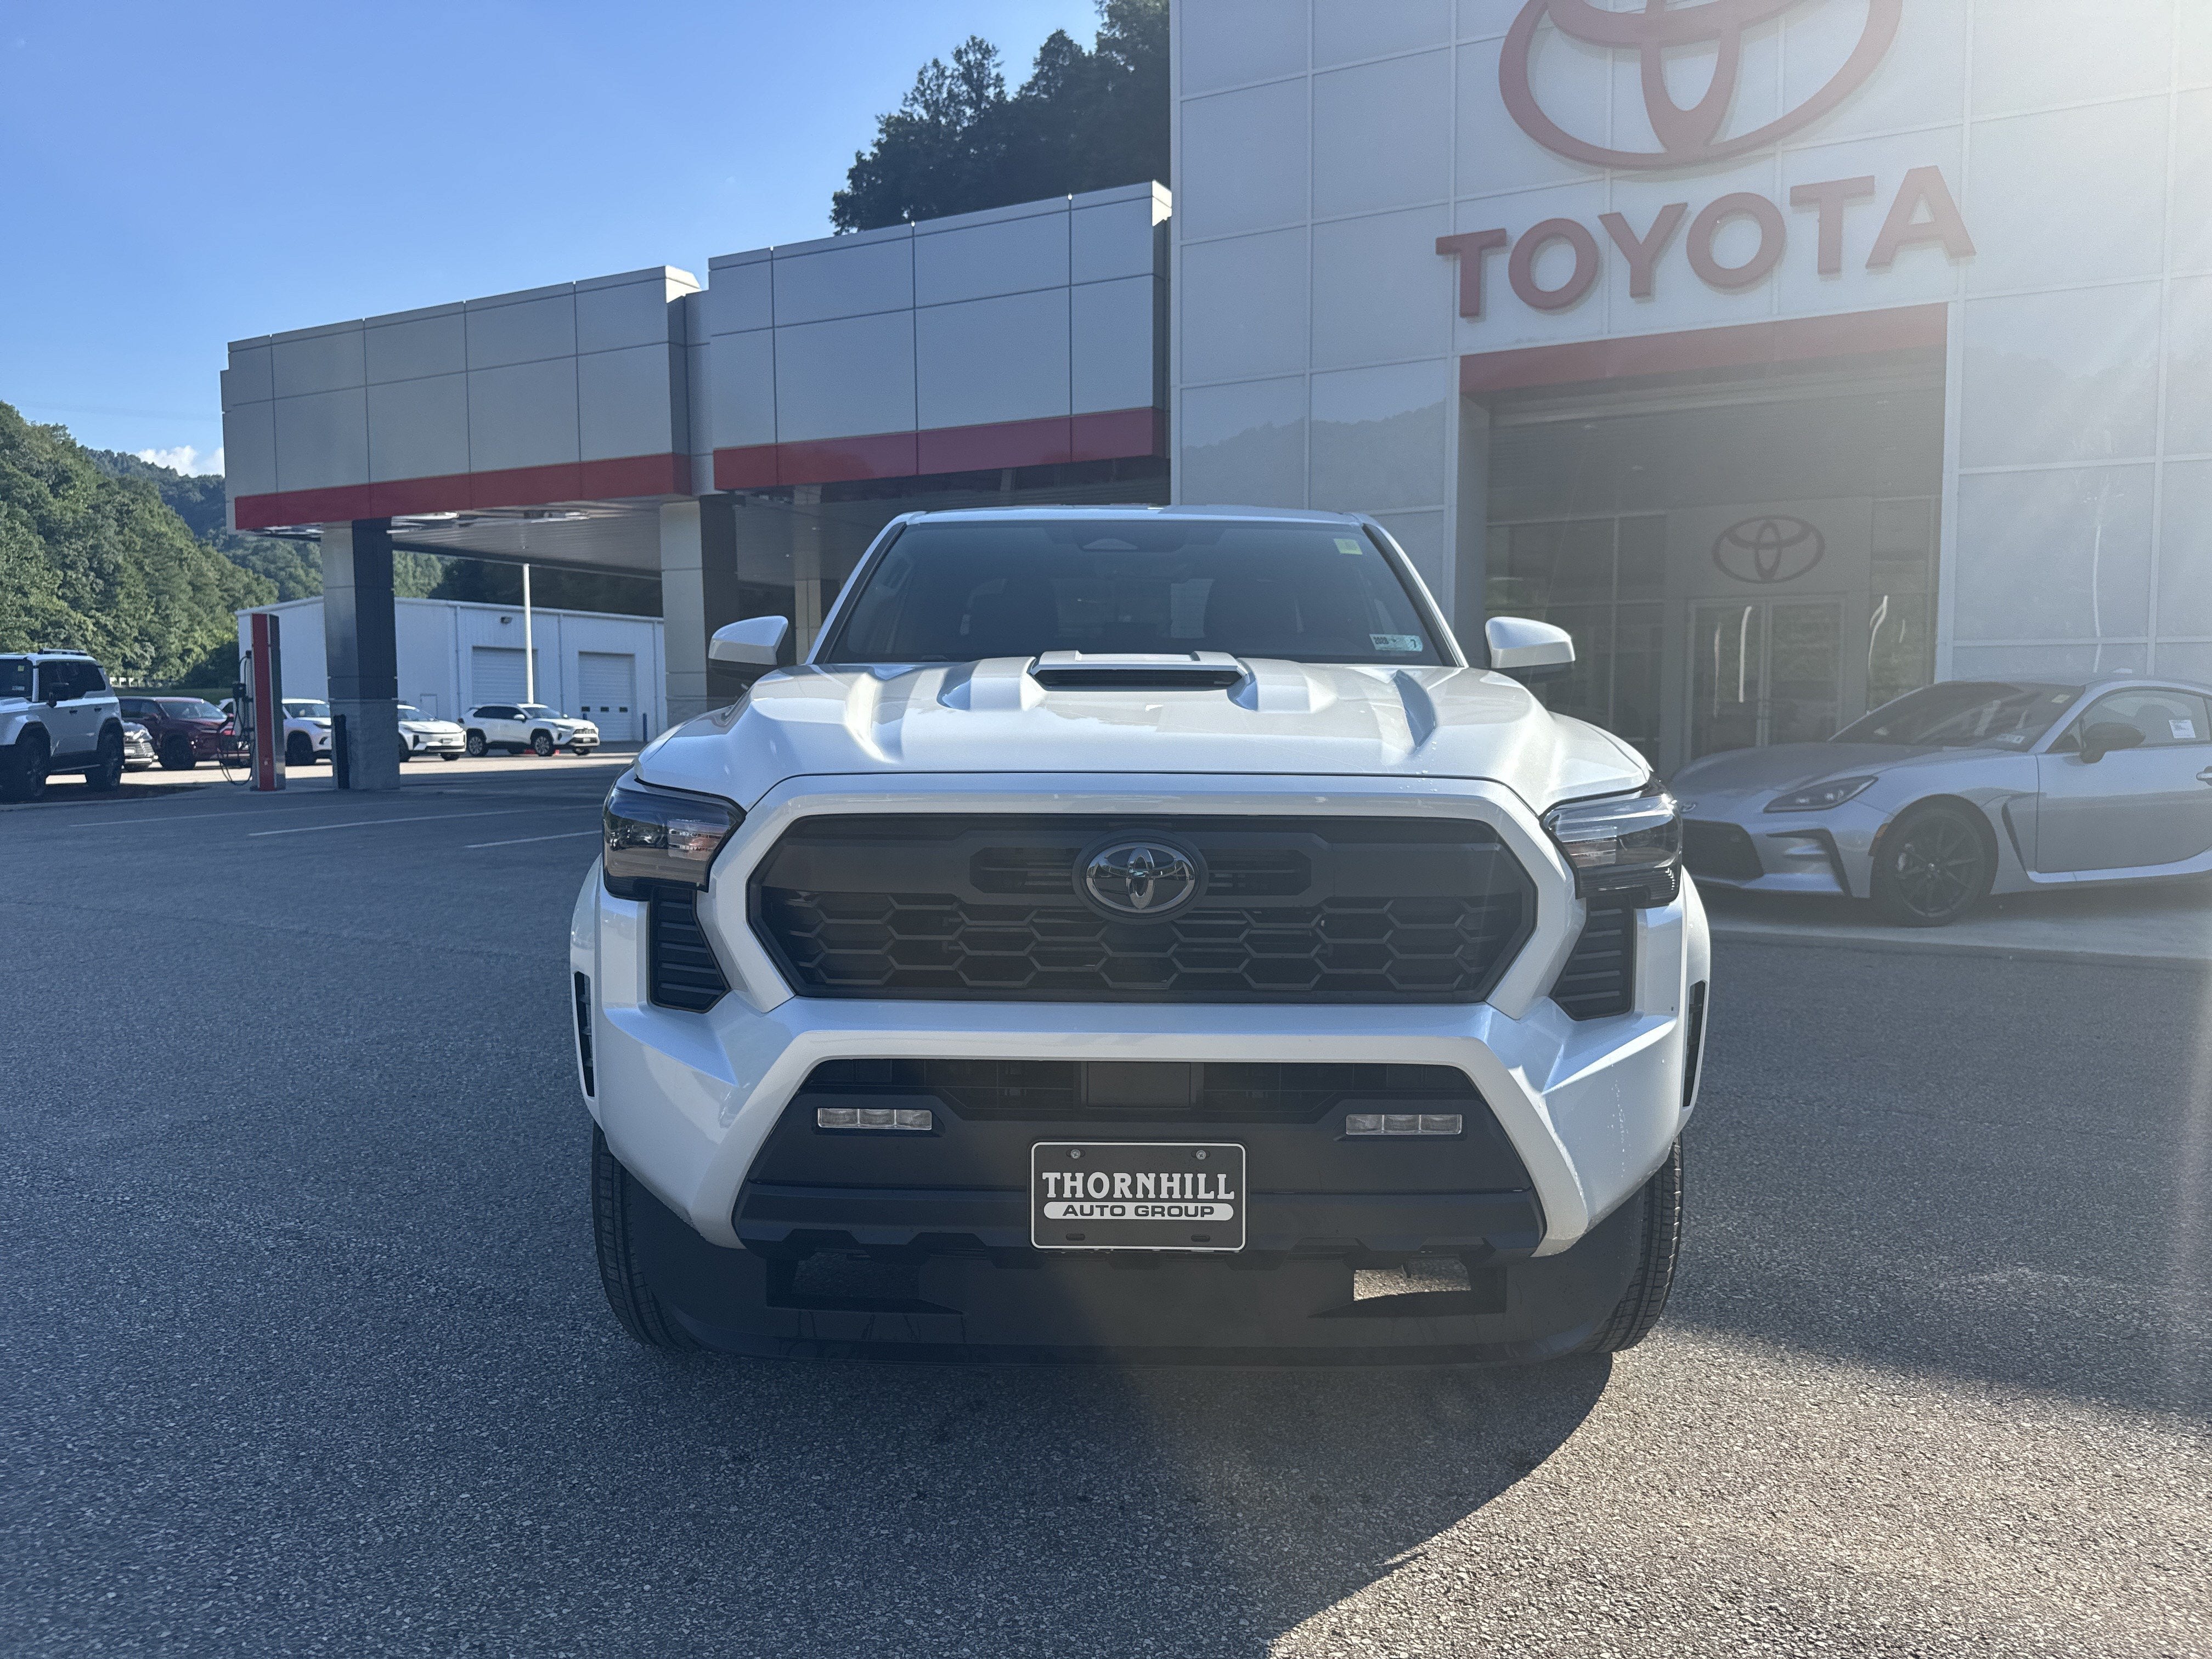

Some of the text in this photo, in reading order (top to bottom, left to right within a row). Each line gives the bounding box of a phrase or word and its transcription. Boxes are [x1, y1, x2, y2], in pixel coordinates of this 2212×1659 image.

[1436, 165, 1976, 318] TOYOTA
[1042, 1171, 1235, 1200] THORNHILL
[1062, 1204, 1215, 1218] AUTO GROUP
